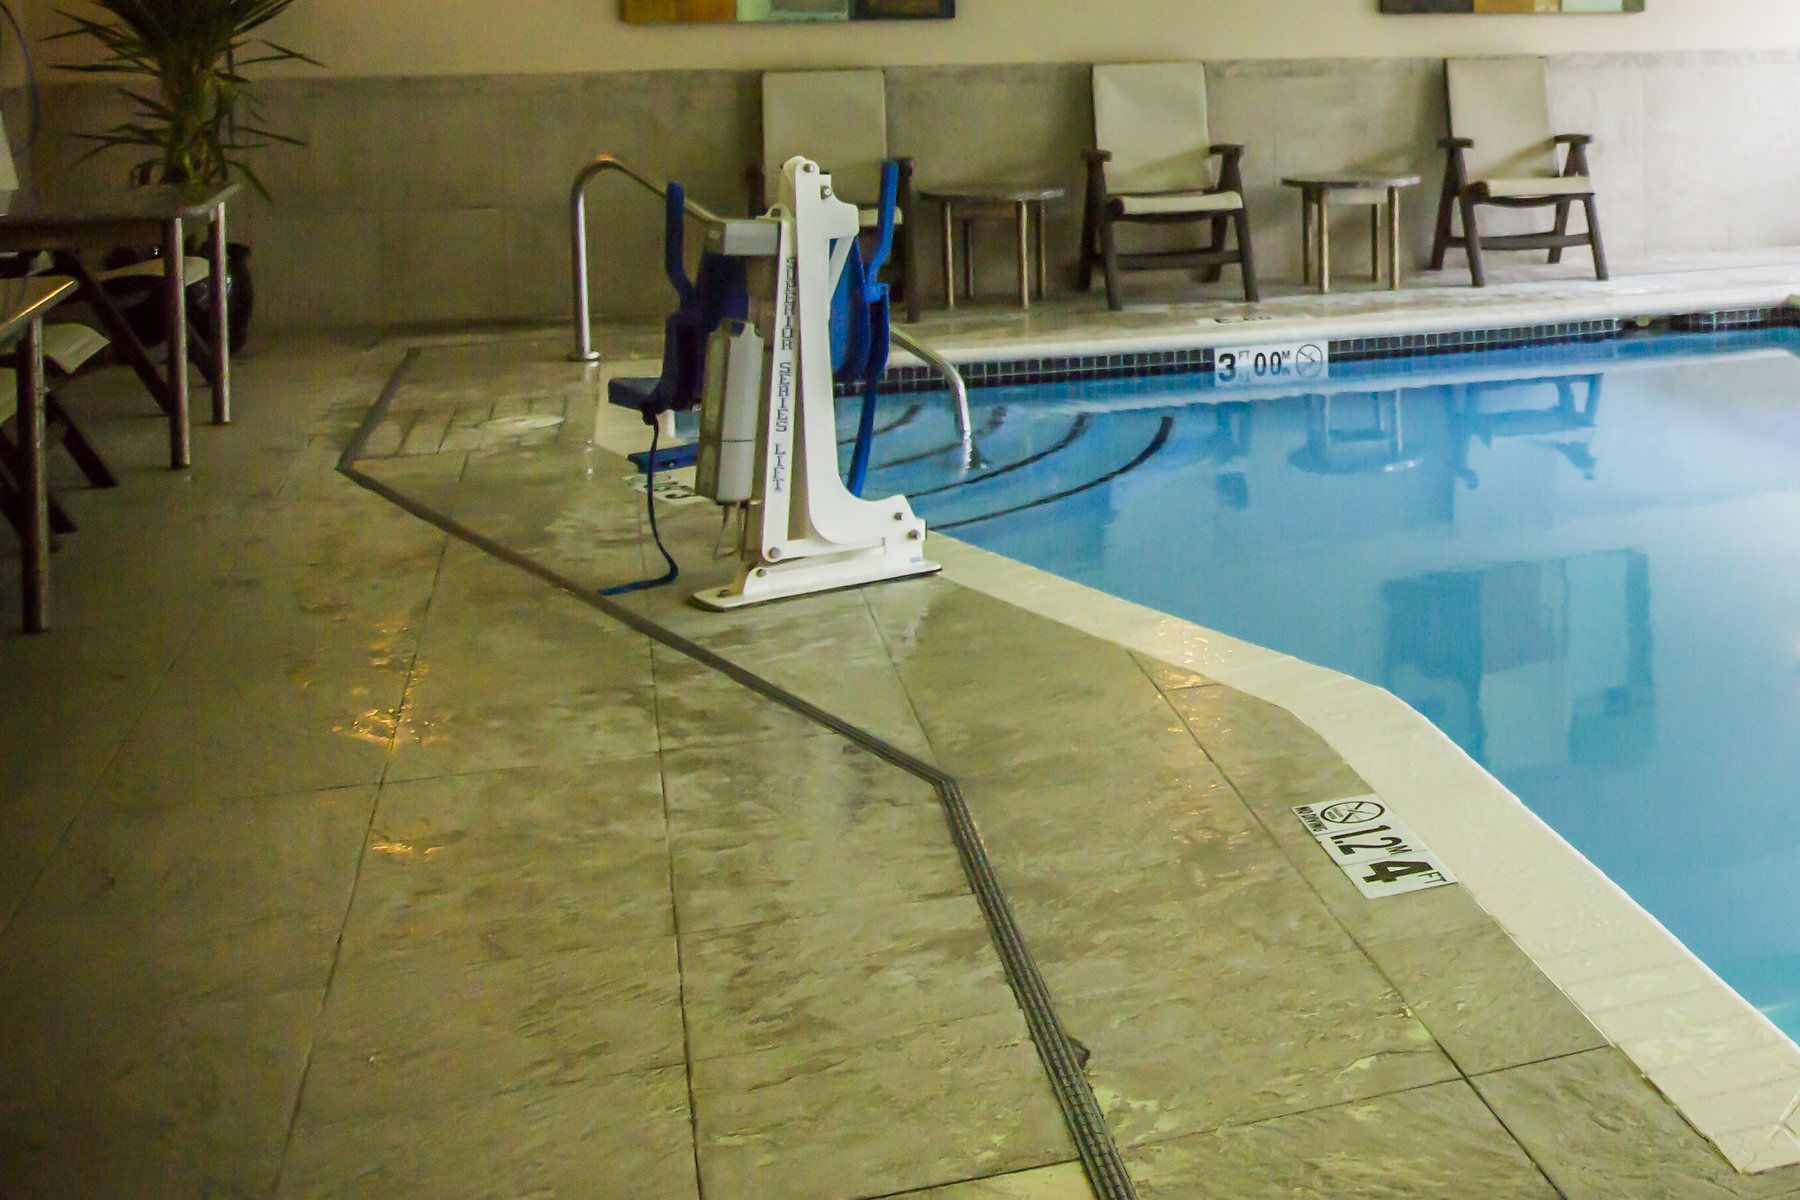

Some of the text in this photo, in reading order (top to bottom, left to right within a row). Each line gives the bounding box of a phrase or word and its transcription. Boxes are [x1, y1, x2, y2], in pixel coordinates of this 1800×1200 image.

[775, 361, 791, 433] SERIES
[772, 443, 786, 492] LIFT
[1387, 844, 1413, 856] M
[1362, 860, 1434, 884] 4
[1418, 870, 1447, 884] FT
